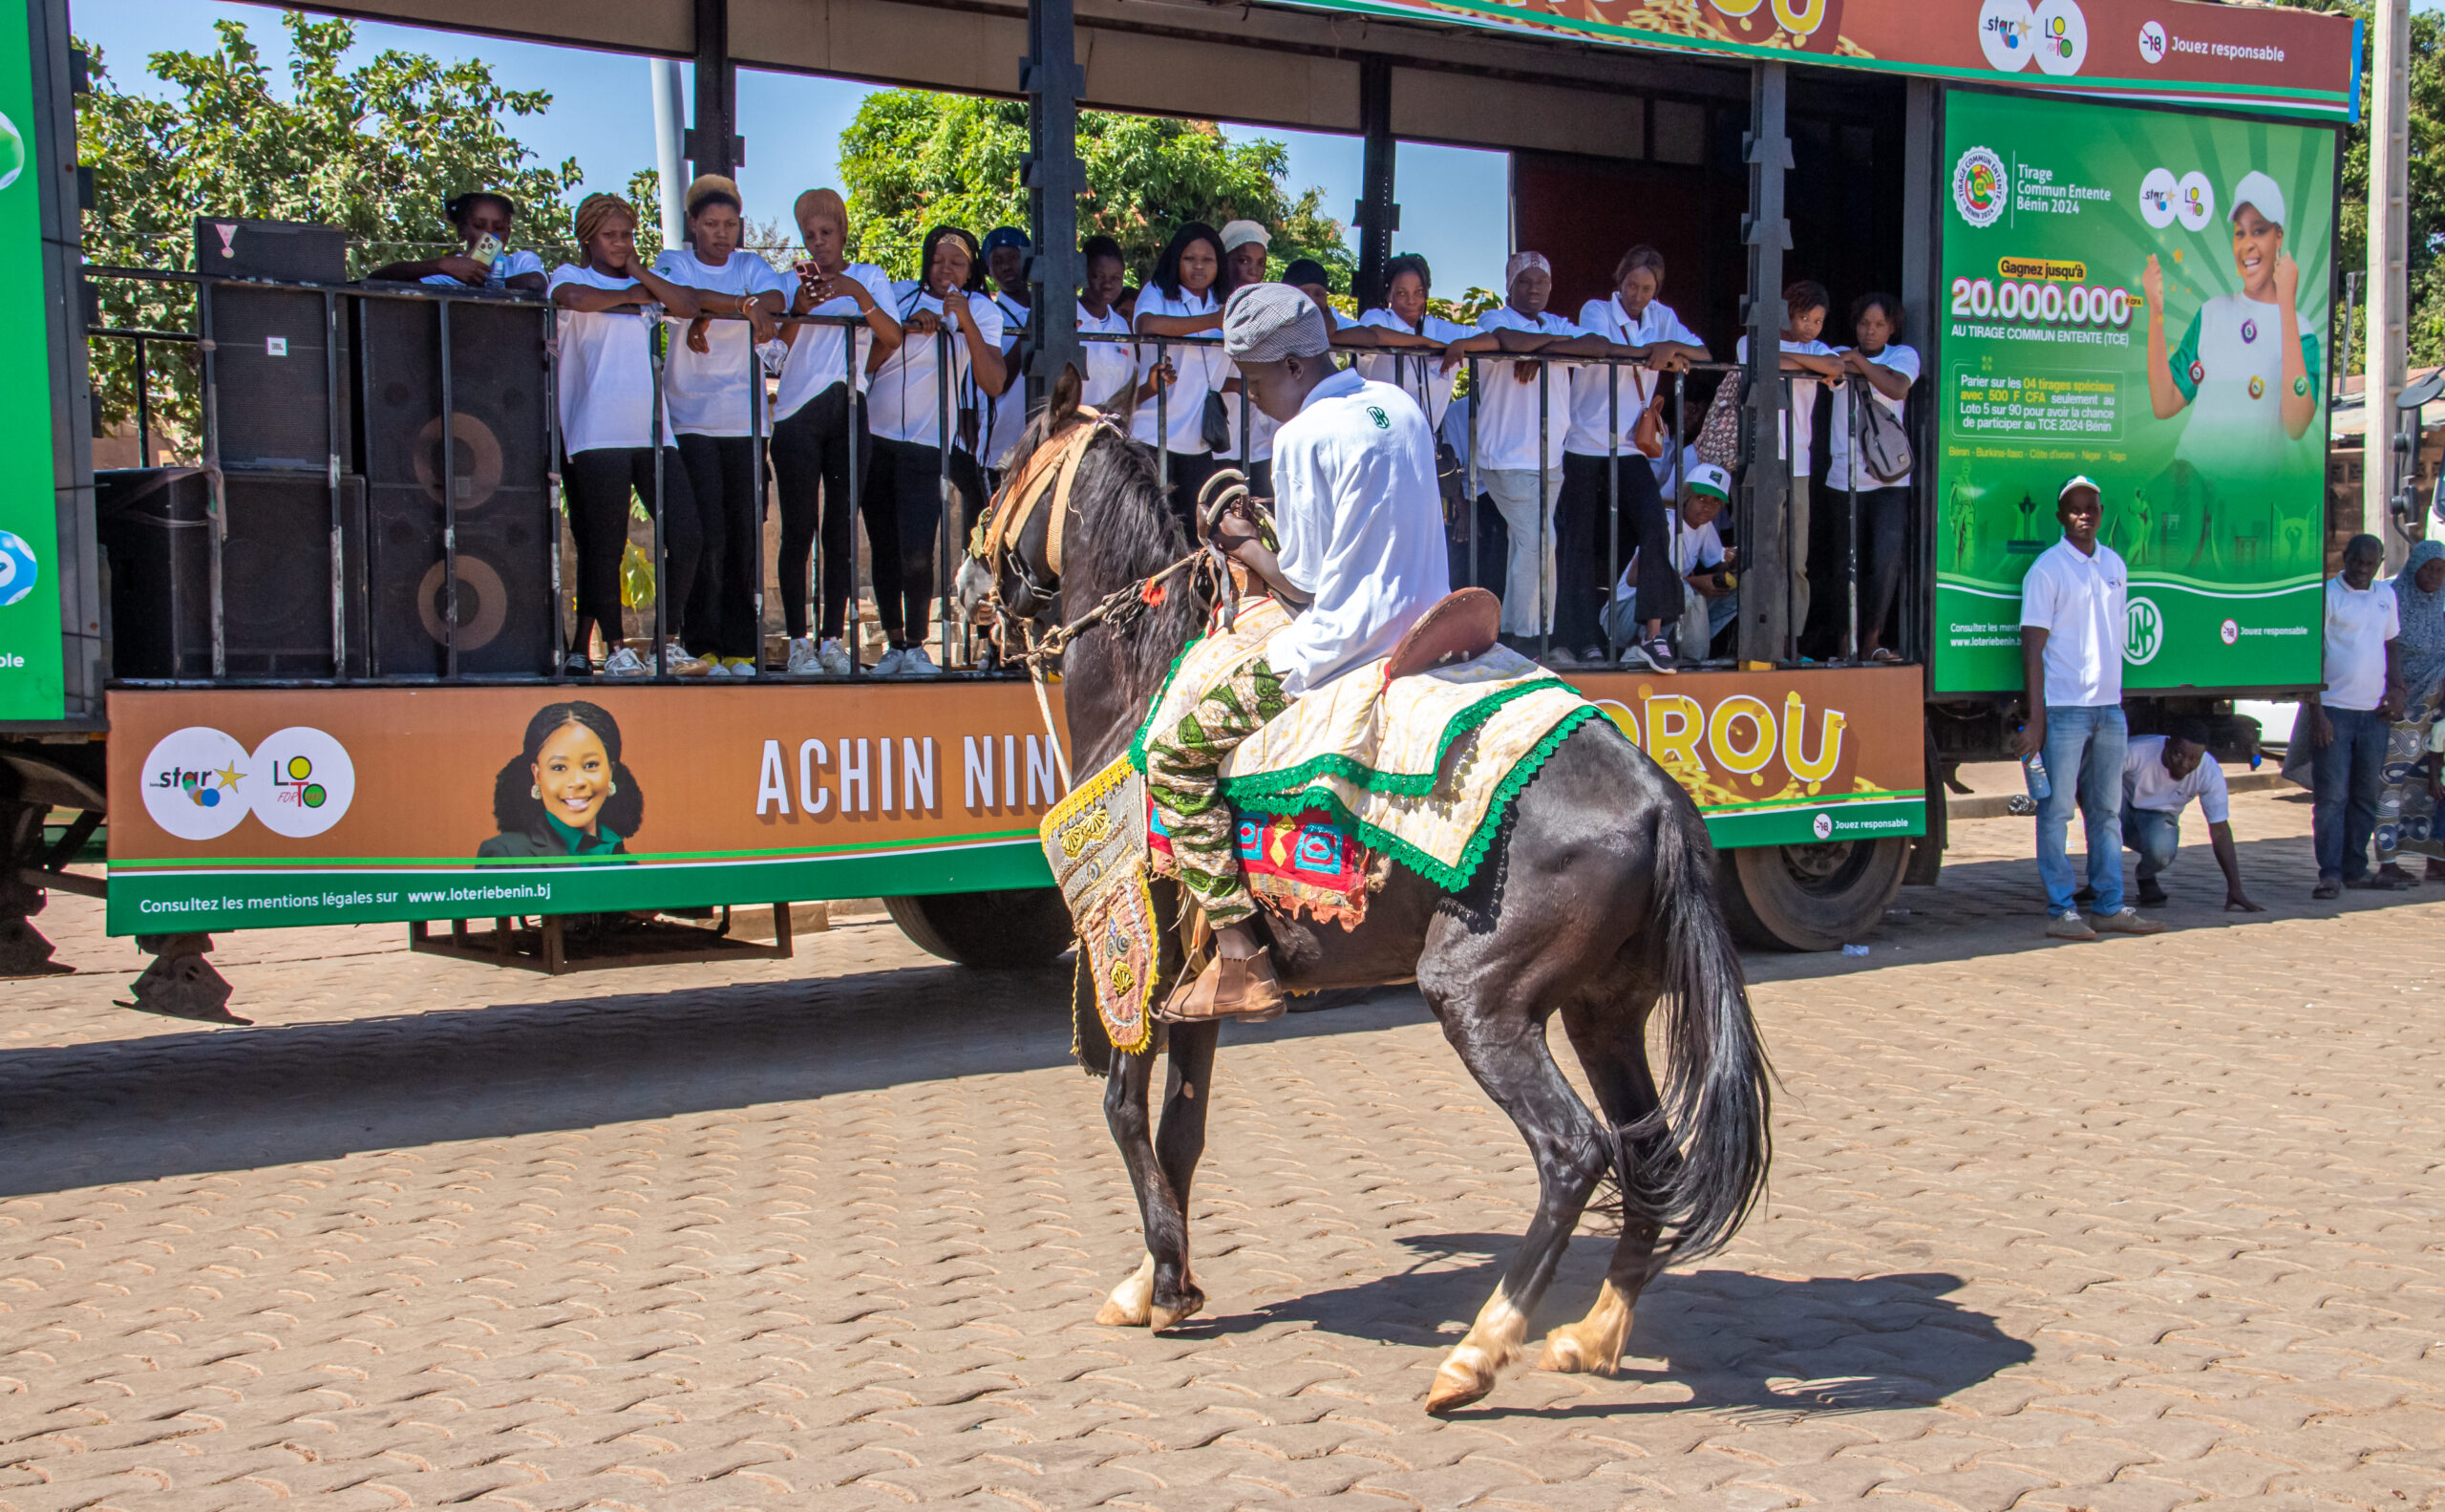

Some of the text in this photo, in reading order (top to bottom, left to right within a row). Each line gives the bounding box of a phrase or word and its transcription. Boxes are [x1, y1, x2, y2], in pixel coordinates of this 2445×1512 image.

[2171, 36, 2208, 54] Jouez
[2211, 43, 2285, 62] responsable
[1965, 155, 1992, 168] COMMUN
[2017, 163, 2053, 184] Tirage
[2017, 180, 2111, 201] Commun Entente
[2017, 196, 2080, 214] Bénin 2024
[2001, 260, 2084, 280] Gagnez jusqu'à
[1951, 279, 2130, 325] 20.000.000
[1951, 324, 2129, 349] AU TIRAGE COMMUN ENTENTE (TCE)
[1961, 374, 2115, 394] Parier sur les 04 tirages spéciaux
[1961, 390, 2115, 406] avec 500 F CFA seulement au
[1961, 401, 2115, 418] Loto 5 sur 90 pour avoir la chance
[1963, 415, 2112, 433] de participer au TCE 2024 Bénin
[1950, 623, 1987, 632] Consultez
[1988, 622, 1998, 631] les
[2241, 627, 2263, 635] Jouez
[2264, 626, 2308, 637] responsable
[1950, 636, 2022, 647] www.loteriebenin.b
[159, 767, 212, 788] star
[756, 736, 934, 815] ACHIN
[1835, 820, 1859, 830] Jouez
[1860, 819, 1908, 830] responsable
[139, 883, 550, 913] Consultez les mentions légales sur www.loteriebenin.bj
